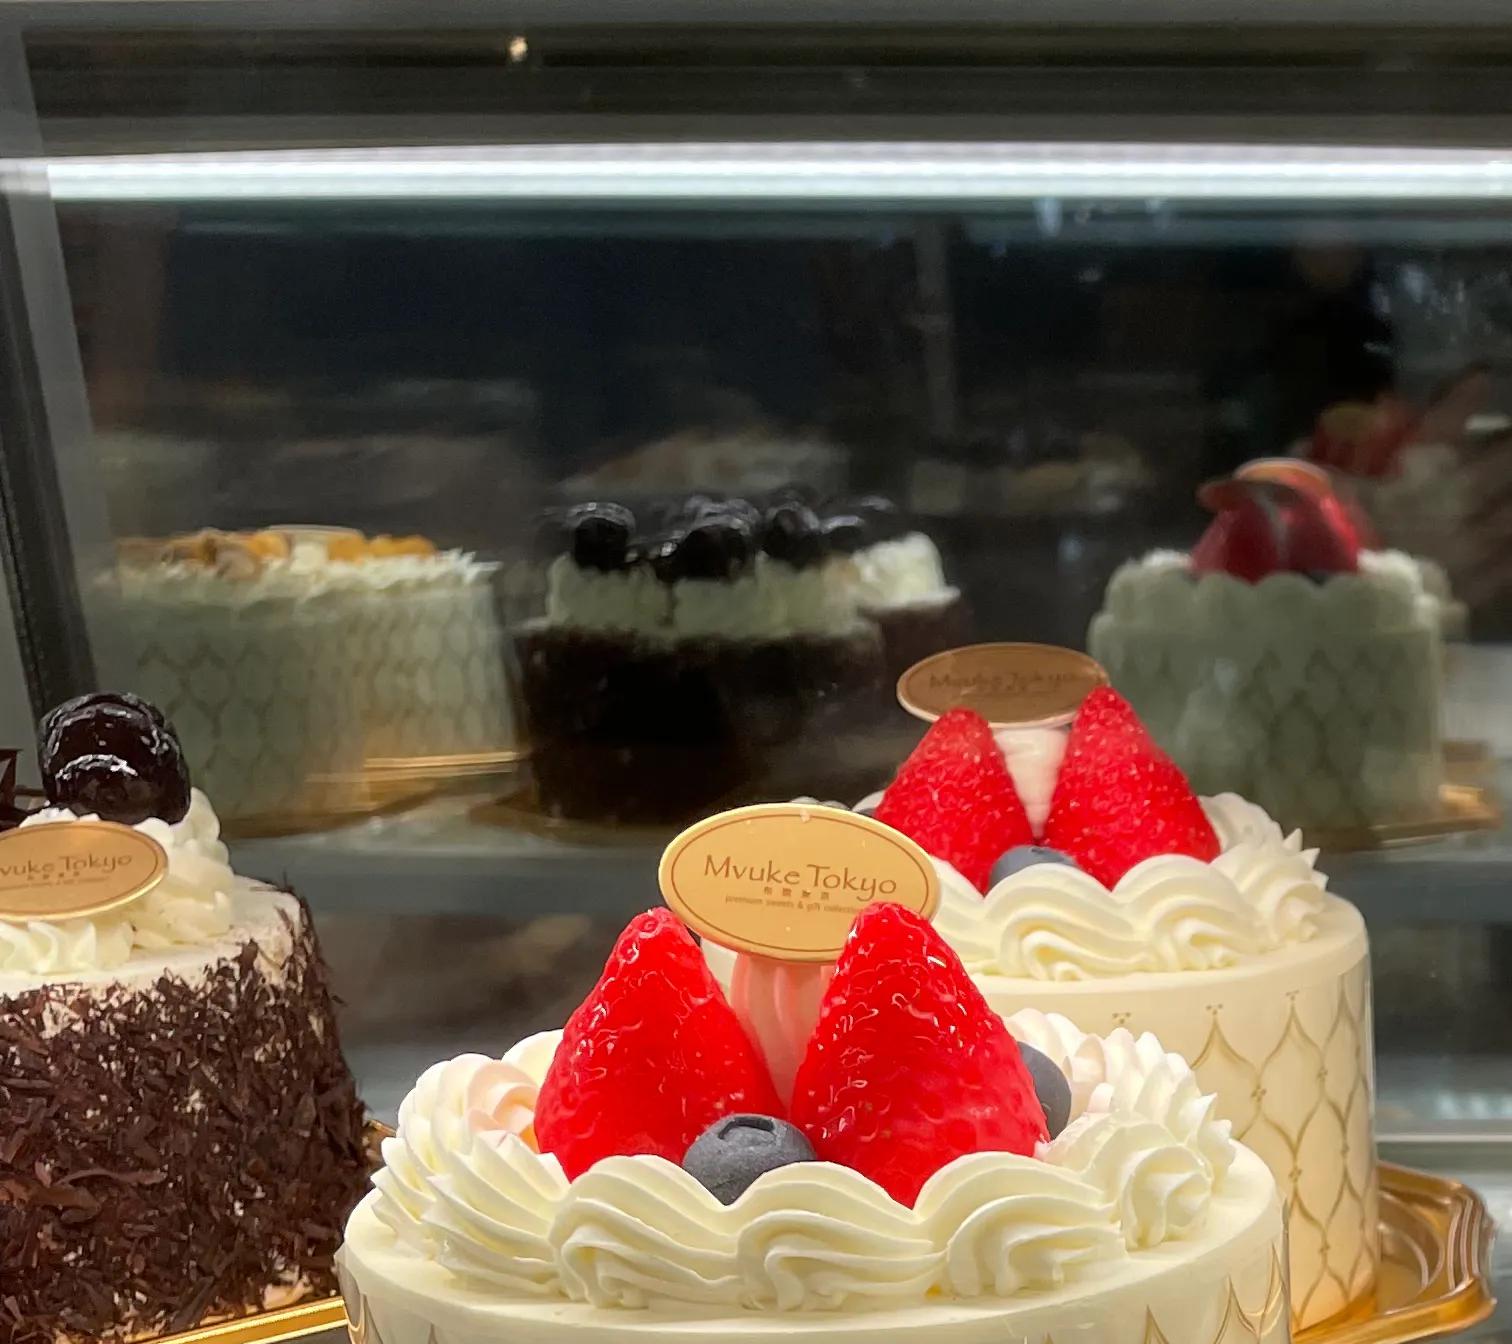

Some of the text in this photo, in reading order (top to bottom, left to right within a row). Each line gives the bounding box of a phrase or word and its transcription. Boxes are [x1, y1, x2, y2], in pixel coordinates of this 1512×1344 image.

[58, 853, 133, 873] Tokyo
[704, 854, 800, 885] Mvuke
[807, 864, 897, 901] Tokyo
